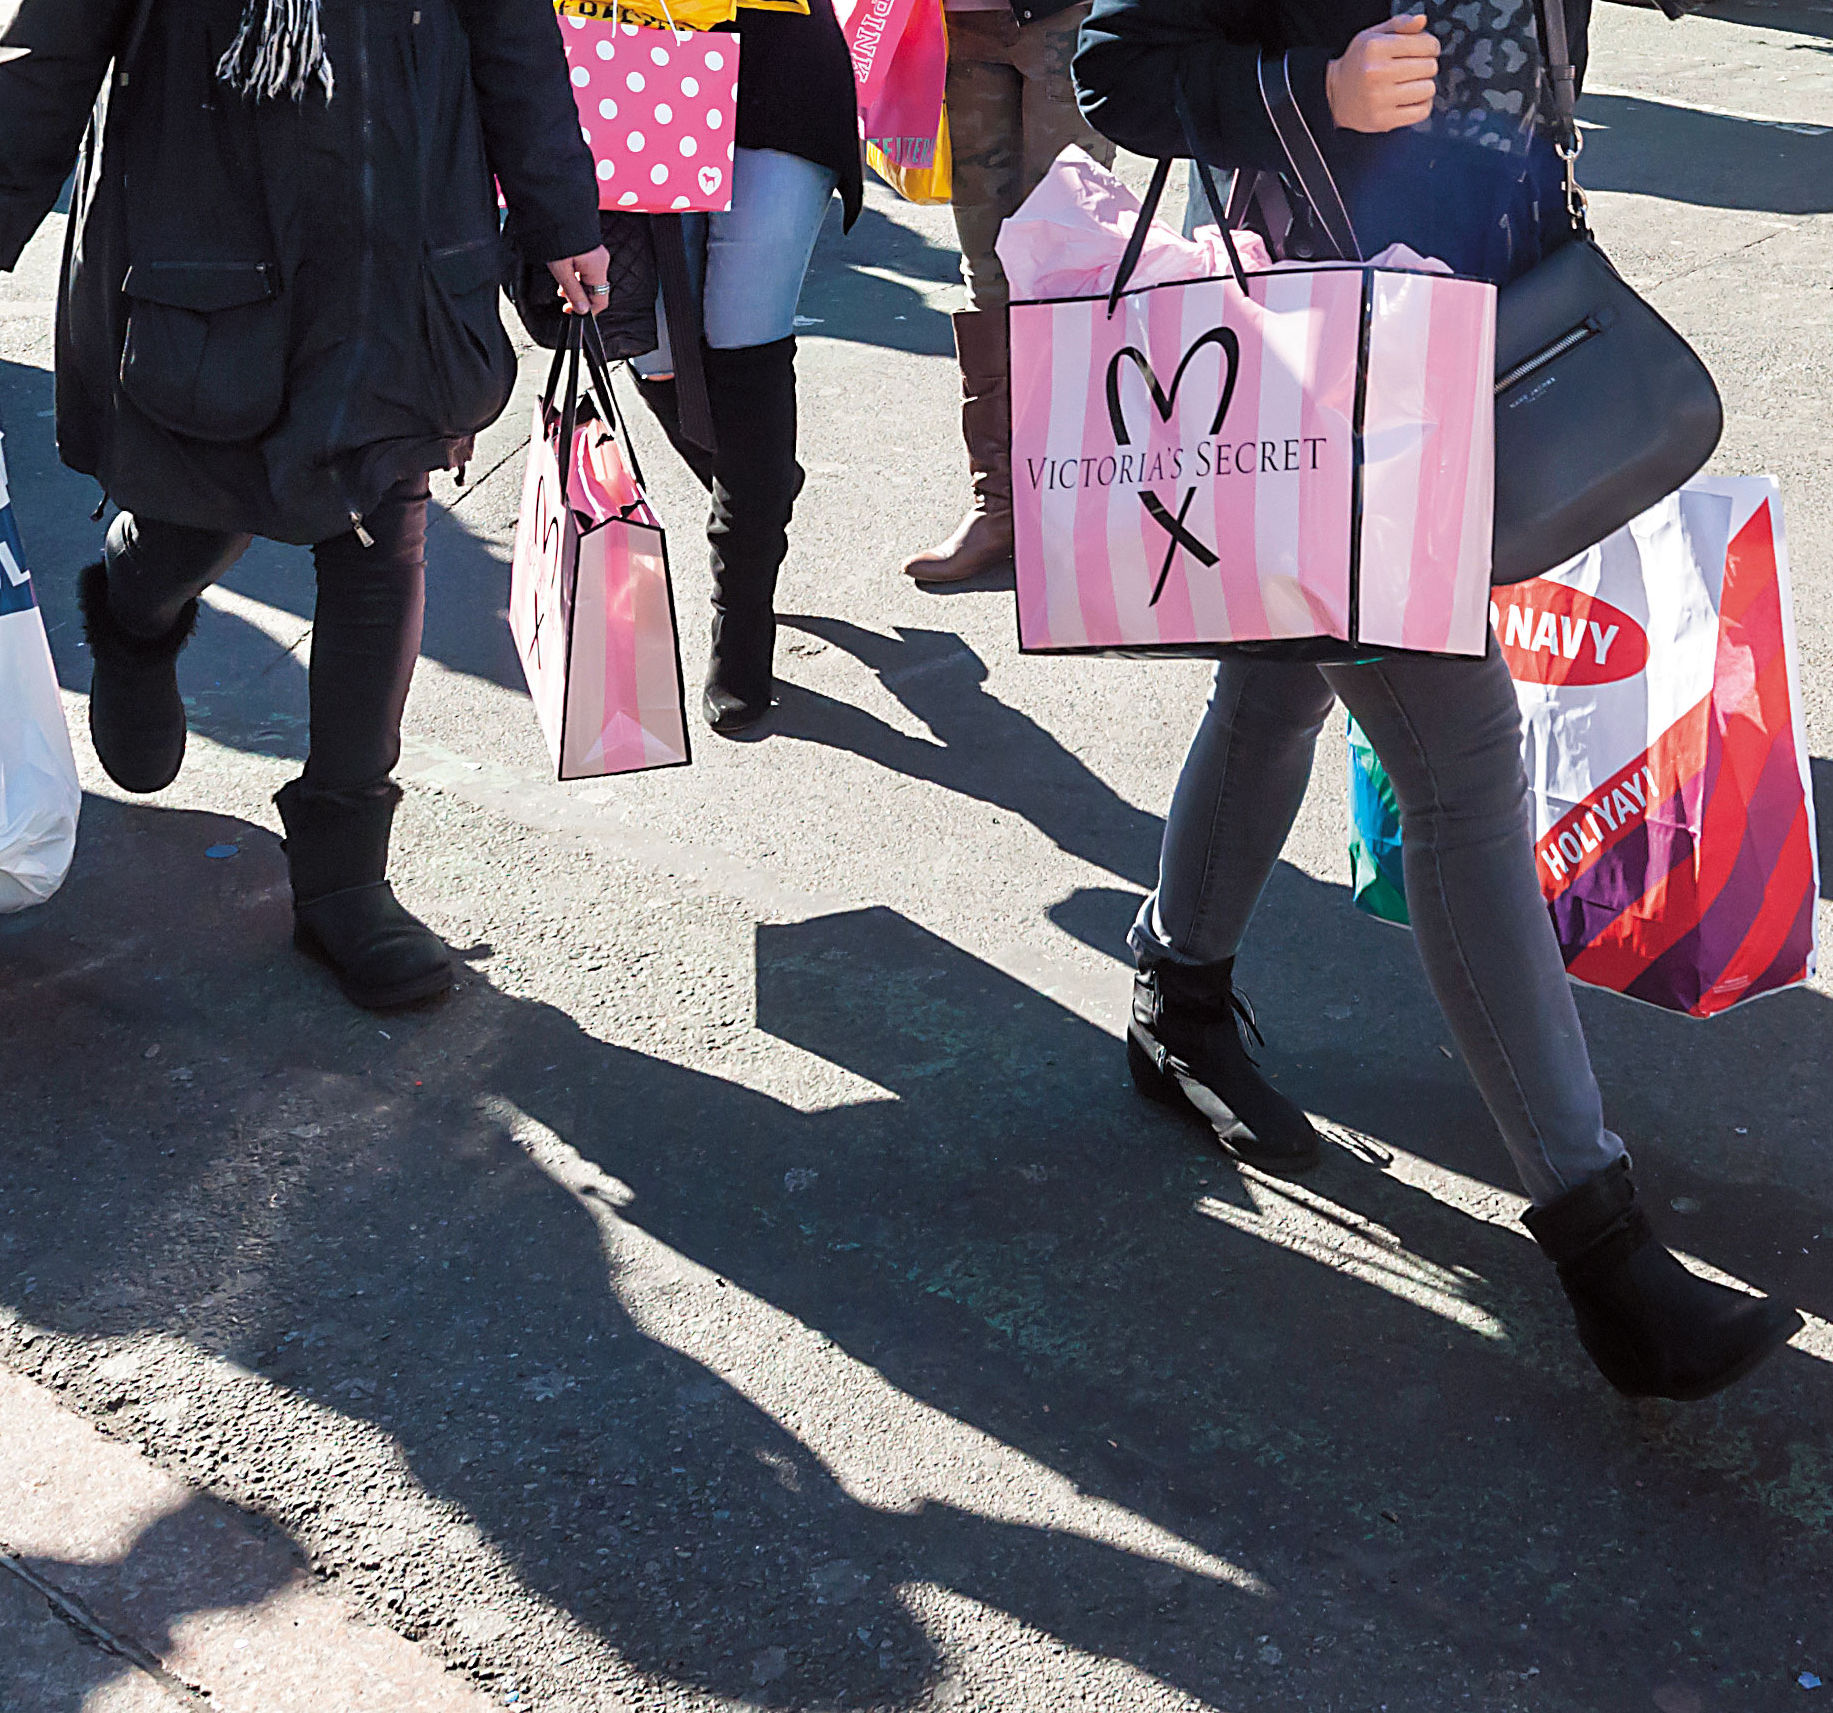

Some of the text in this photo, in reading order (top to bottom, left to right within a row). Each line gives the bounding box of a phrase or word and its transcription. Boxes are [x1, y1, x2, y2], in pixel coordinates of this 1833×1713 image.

[1027, 437, 1327, 491] VICTORIA'S SECRET
[1504, 604, 1620, 666] NAVY
[1540, 765, 1660, 881] HOLIYAY!
